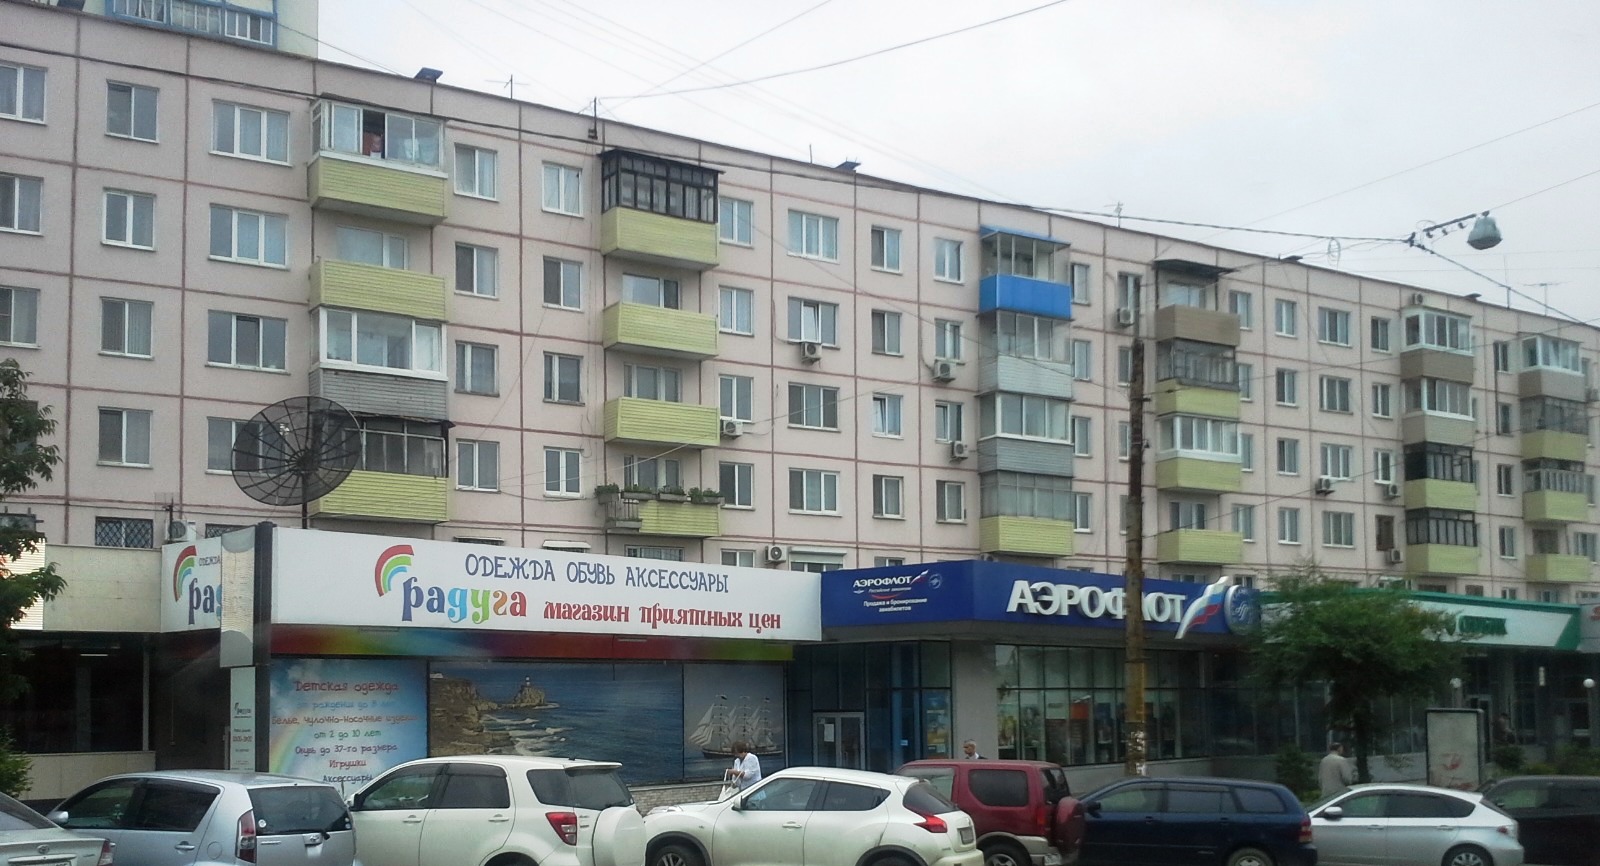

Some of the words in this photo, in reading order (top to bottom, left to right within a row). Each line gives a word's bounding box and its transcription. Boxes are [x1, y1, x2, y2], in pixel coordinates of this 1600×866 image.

[465, 553, 555, 582] ОДЕЖДА
[567, 561, 615, 585] ОБУВЬ
[625, 566, 729, 593] АКСЕССУАРЫ
[853, 576, 912, 588] АЭРОФЛОТ
[543, 601, 629, 622] магазин
[639, 602, 742, 629] приятных
[749, 613, 781, 634] цен
[294, 681, 348, 692] Детская
[353, 682, 399, 695] одежда
[329, 730, 335, 738] 2
[338, 731, 349, 740] до
[351, 729, 361, 738] 10
[320, 747, 330, 757] до
[329, 759, 367, 770] Игрушки
